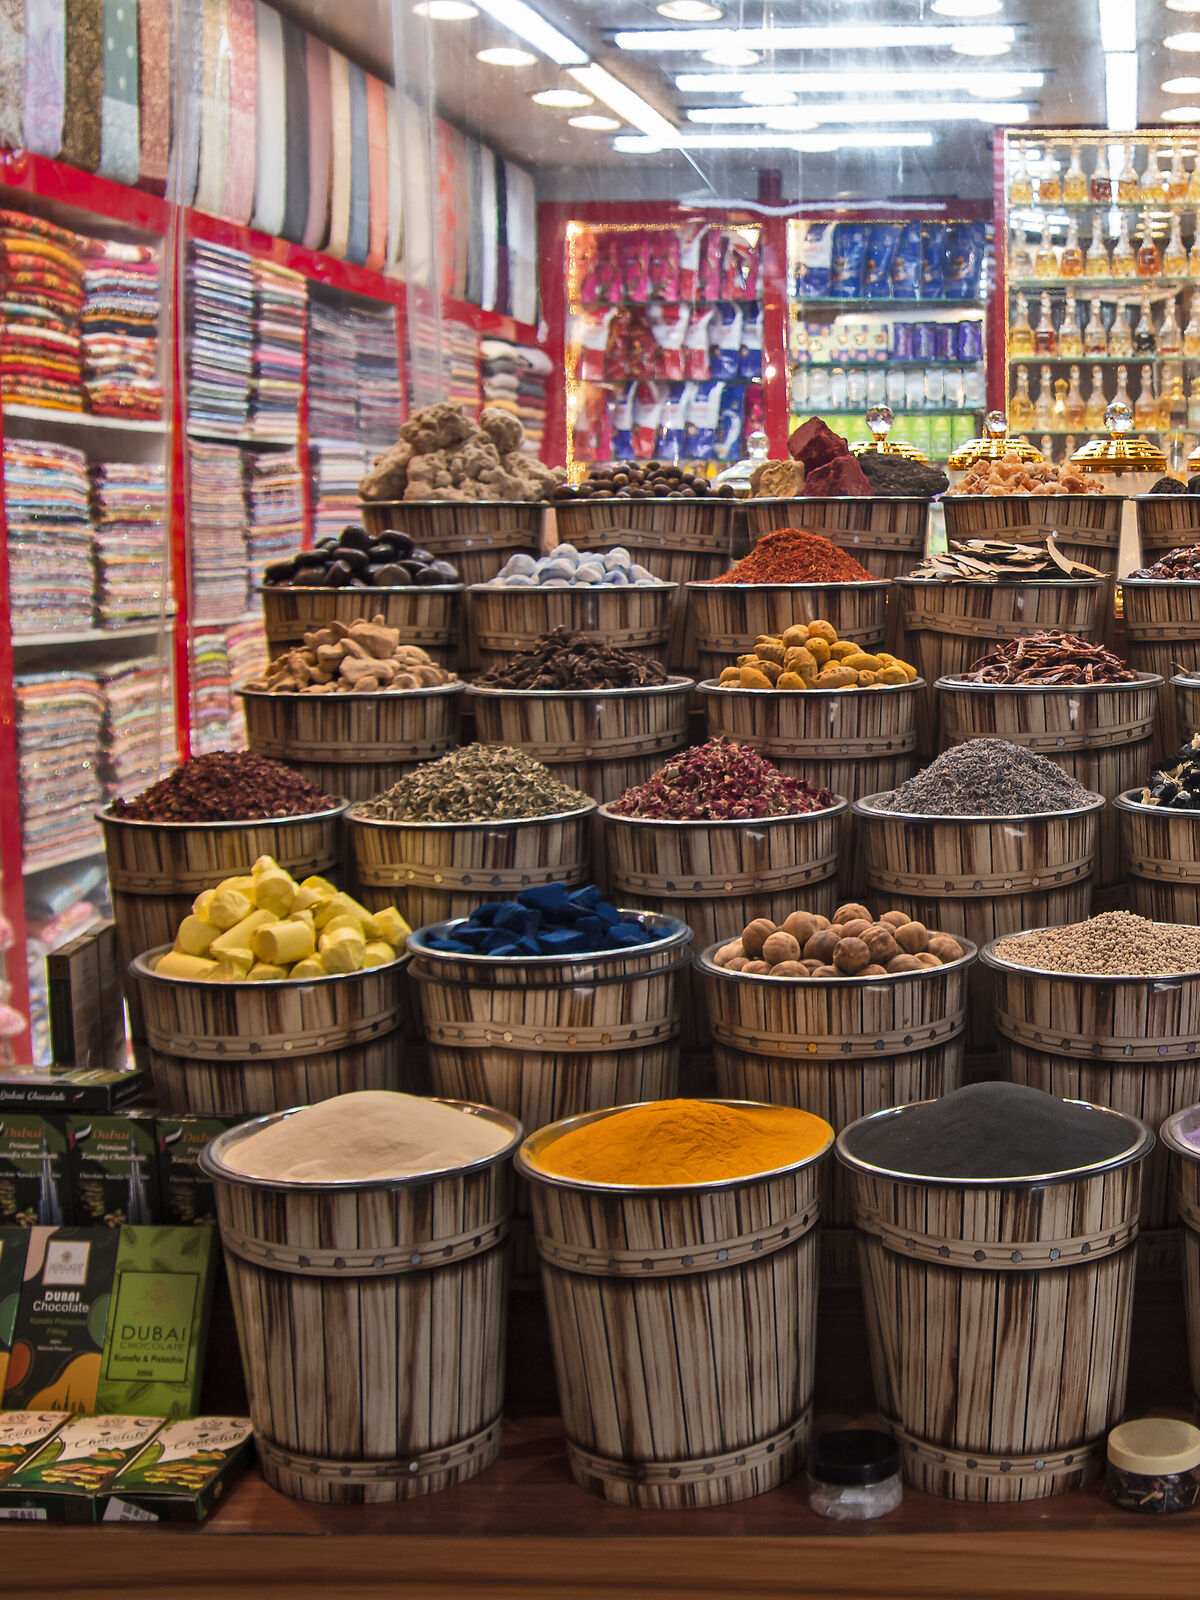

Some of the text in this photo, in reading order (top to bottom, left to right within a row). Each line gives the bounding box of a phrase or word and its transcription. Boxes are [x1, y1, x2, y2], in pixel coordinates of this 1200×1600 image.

[27, 1088, 65, 1102] Chocolate
[4, 1127, 43, 1138] Dubai
[92, 1128, 130, 1140] Dubai
[45, 1291, 80, 1302] DUBAI
[33, 1300, 89, 1313] Chocolate
[121, 1325, 186, 1341] DUBAI
[120, 1341, 185, 1352] CHOCOLATE
[113, 1354, 185, 1364] Kunafa & Pistachio
